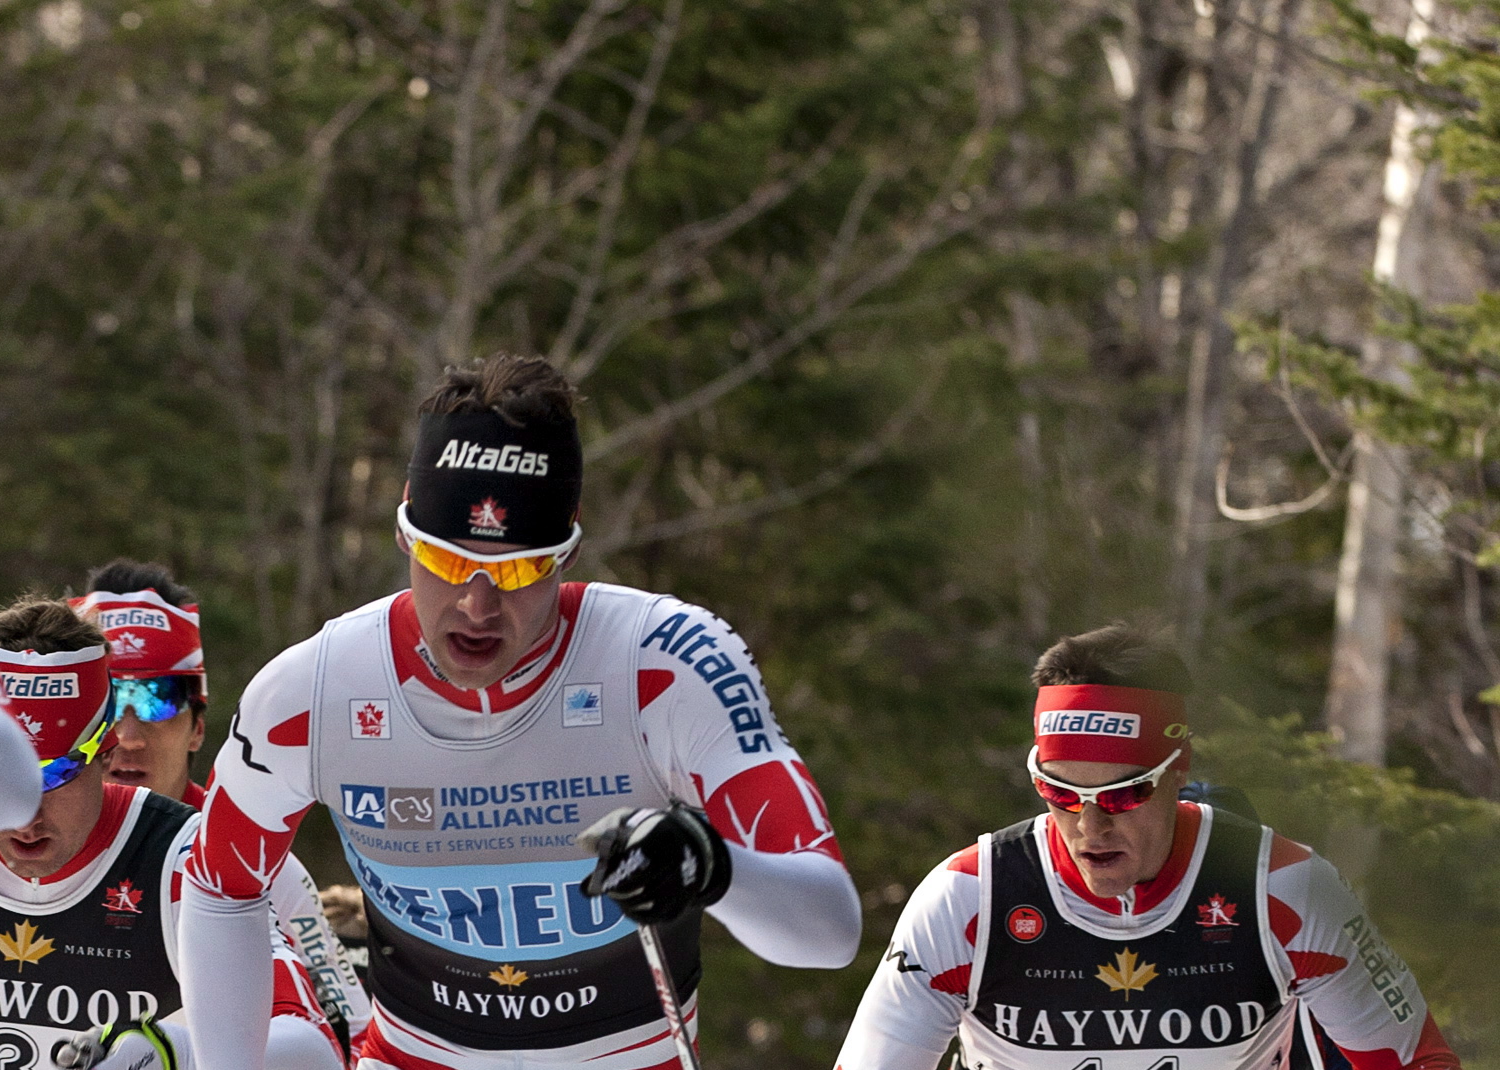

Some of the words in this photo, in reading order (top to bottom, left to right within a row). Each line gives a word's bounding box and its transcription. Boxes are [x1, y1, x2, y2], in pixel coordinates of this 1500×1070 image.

[436, 439, 549, 476] AltaGas
[640, 612, 773, 754] AltaGas
[1042, 713, 1135, 735] AltaGas
[441, 774, 633, 807] INDUSTRIELLE
[440, 804, 580, 831] ALLIANCE
[349, 829, 420, 854] ASSURANCE
[426, 841, 442, 853] ET
[448, 837, 515, 852] SERVICES
[520, 834, 578, 848] FINANC
[64, 944, 132, 959] MARKETS
[1025, 968, 1085, 979] CAPITAL
[1167, 962, 1234, 977] MARKETS
[431, 980, 598, 1020] HAYWOOD
[993, 1001, 1267, 1047] HAYWOOD
